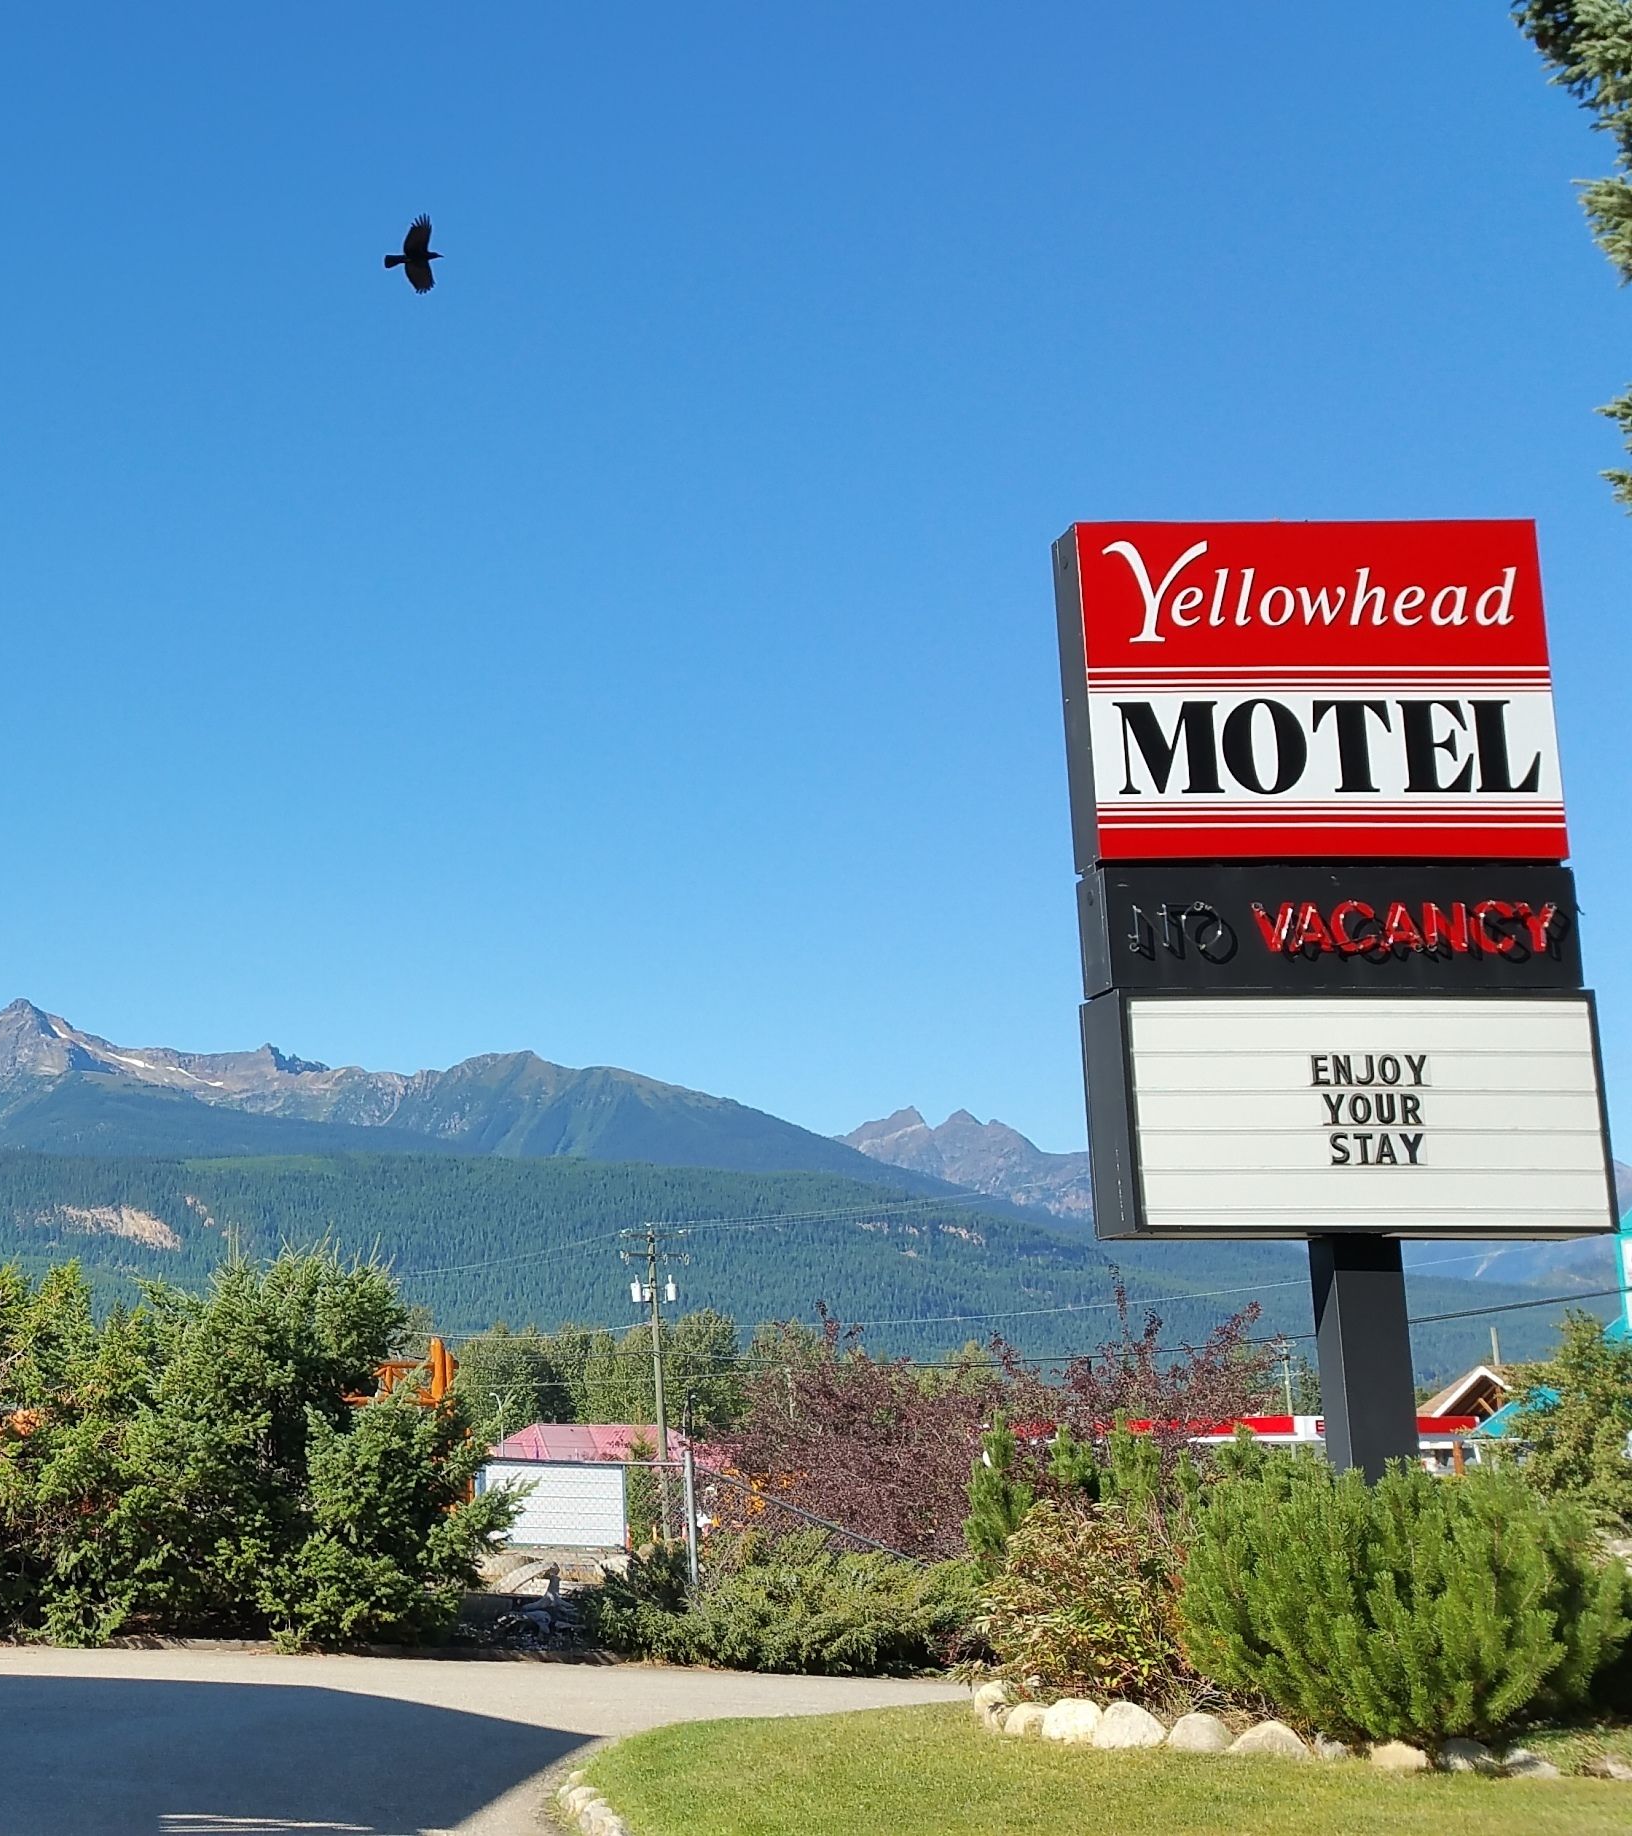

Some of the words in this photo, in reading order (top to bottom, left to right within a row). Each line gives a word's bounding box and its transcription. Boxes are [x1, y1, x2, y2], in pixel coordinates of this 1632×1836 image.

[1101, 540, 1518, 643] Yellowhead
[1112, 697, 1542, 796] MOTEL
[1250, 901, 1557, 953] VACANCY
[1311, 1054, 1427, 1085] ENJOY
[1322, 1093, 1423, 1124] YOUR
[1329, 1132, 1424, 1164] STAY
